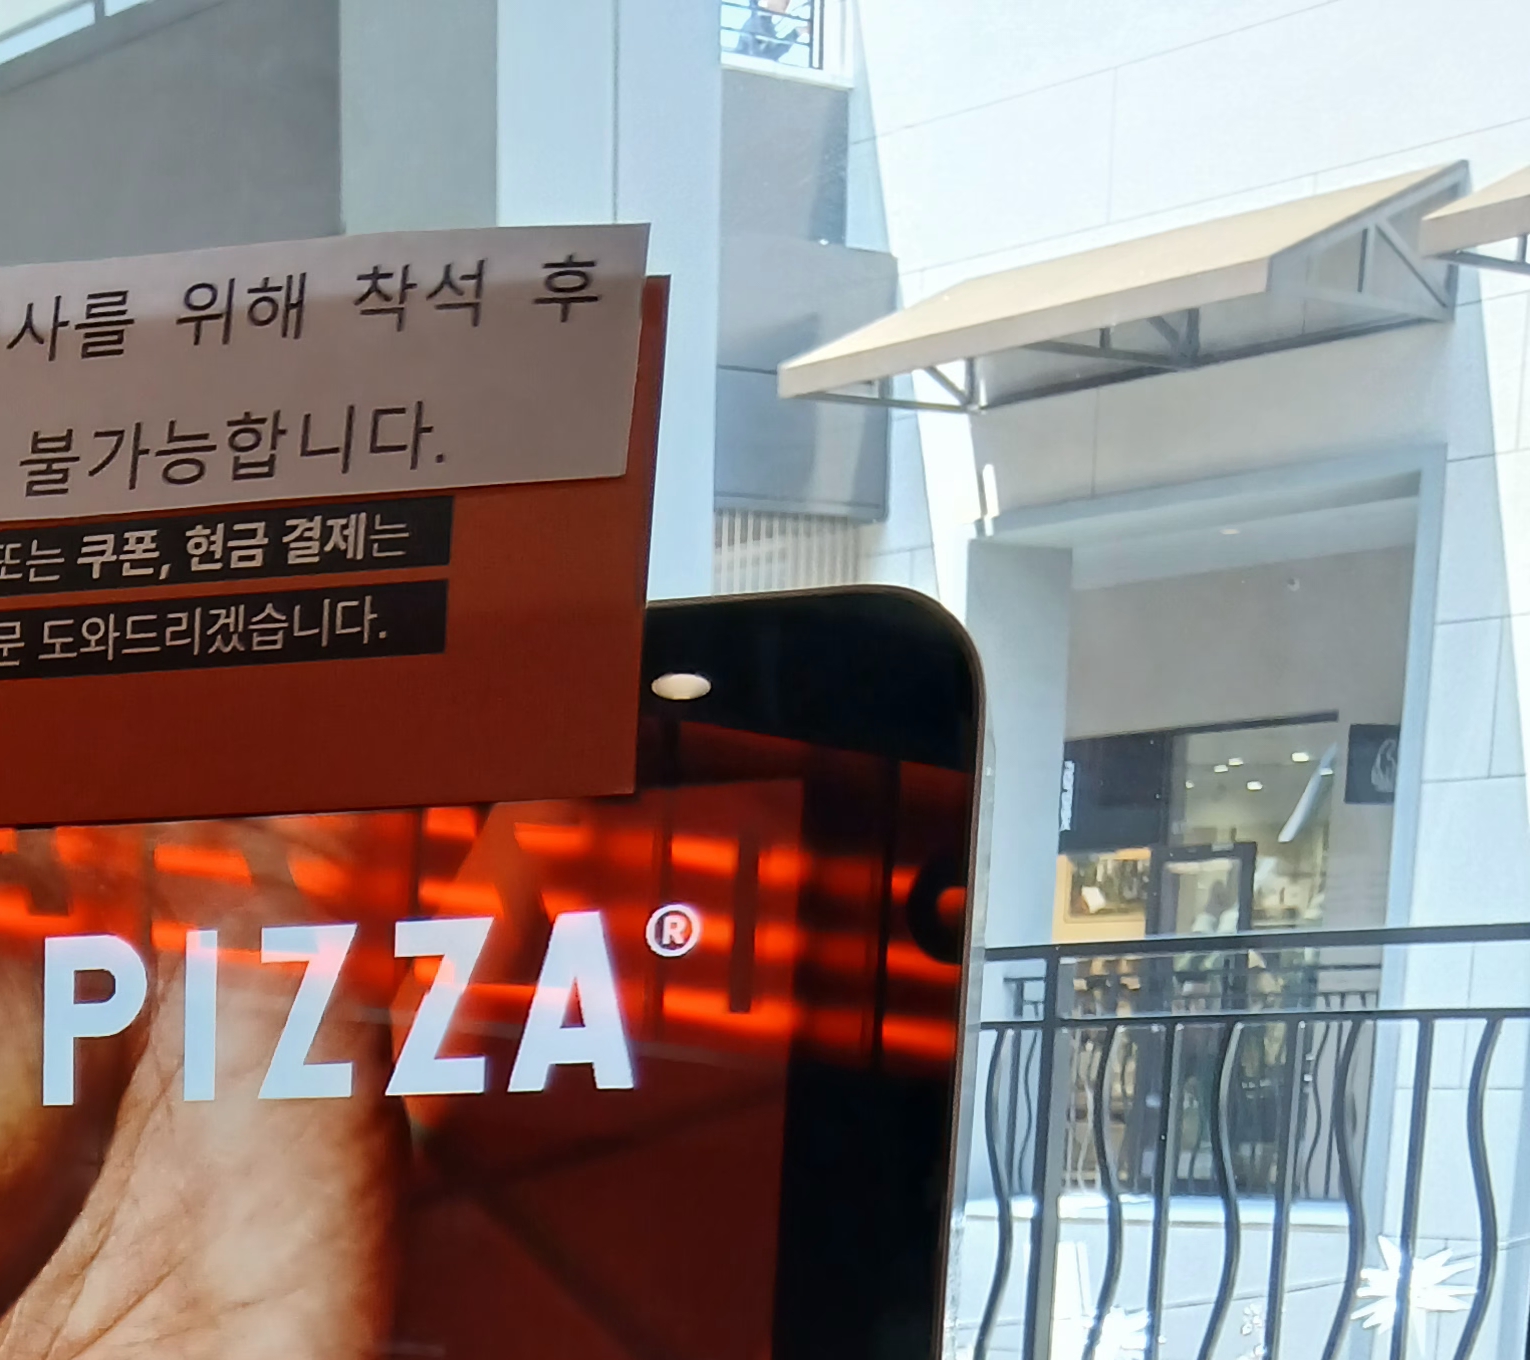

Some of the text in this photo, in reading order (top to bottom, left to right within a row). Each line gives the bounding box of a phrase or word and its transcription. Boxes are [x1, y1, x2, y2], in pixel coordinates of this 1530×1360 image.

[176, 272, 307, 346] 위해
[352, 258, 486, 333] 착석
[531, 253, 602, 323] 후
[19, 400, 446, 499] 불가능합니다.
[76, 528, 169, 583] 쿠폰,
[185, 521, 269, 573] 현금
[281, 513, 410, 564] 결제는
[37, 594, 388, 663] 도와드리겠습니다.
